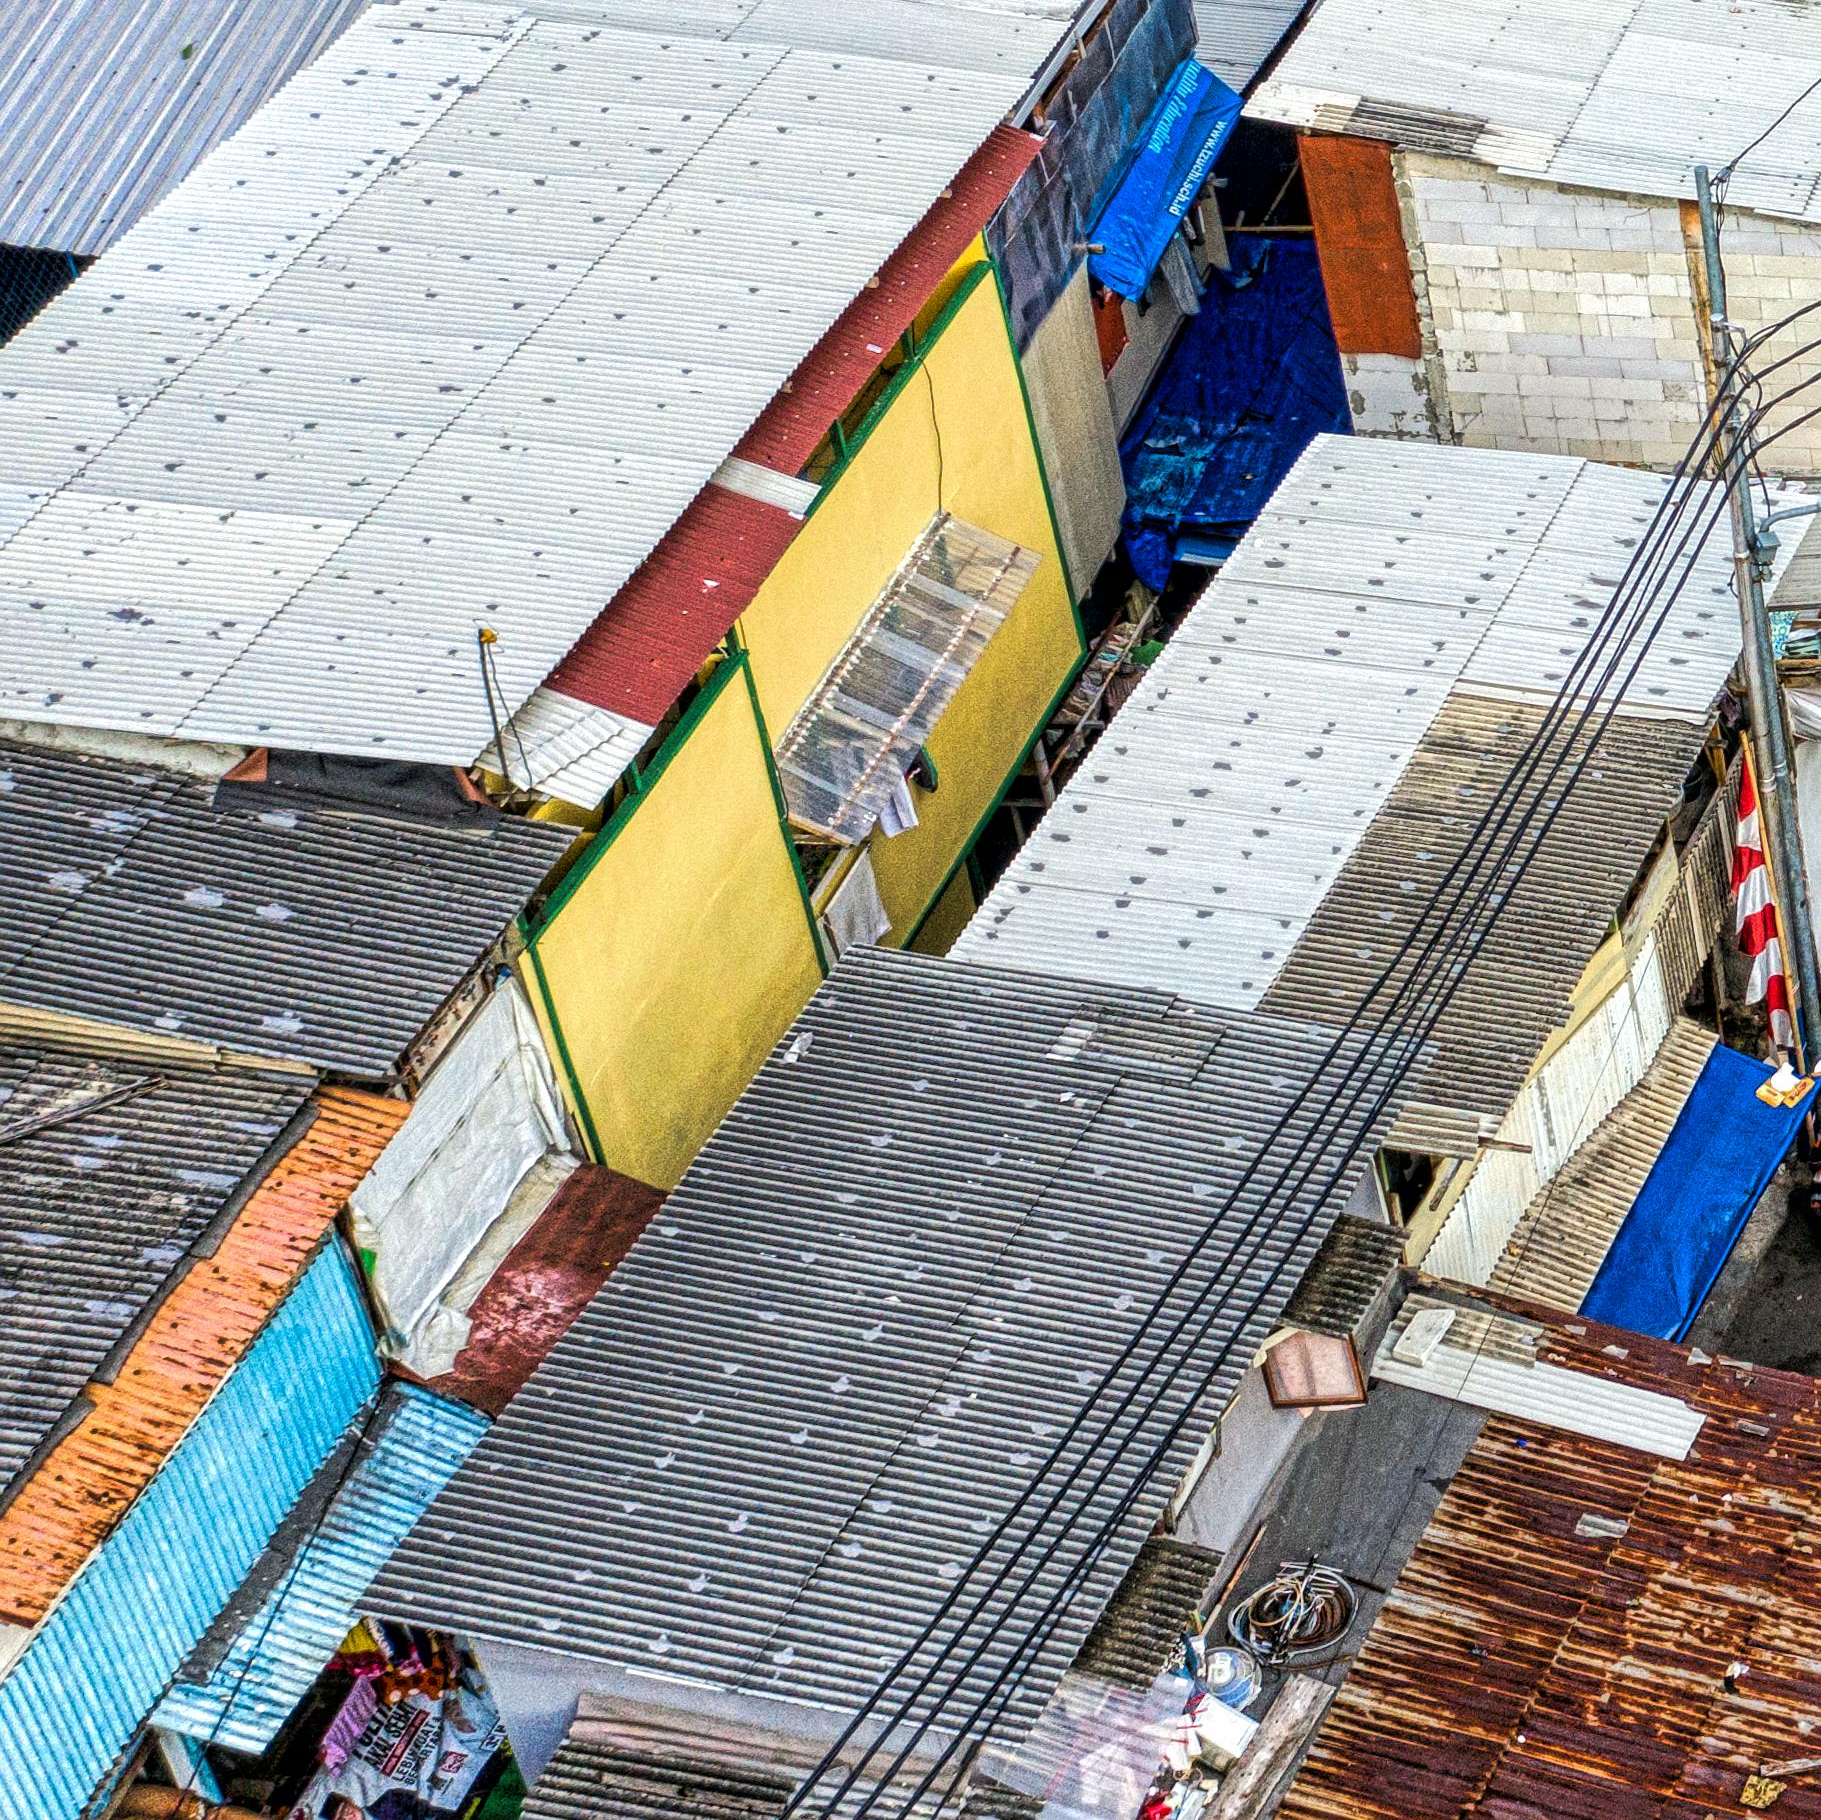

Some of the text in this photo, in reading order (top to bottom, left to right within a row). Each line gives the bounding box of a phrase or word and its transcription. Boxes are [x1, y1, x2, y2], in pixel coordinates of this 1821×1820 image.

[1148, 62, 1202, 155] uality Education
[1167, 119, 1228, 217] www.tzuchi.sch.id
